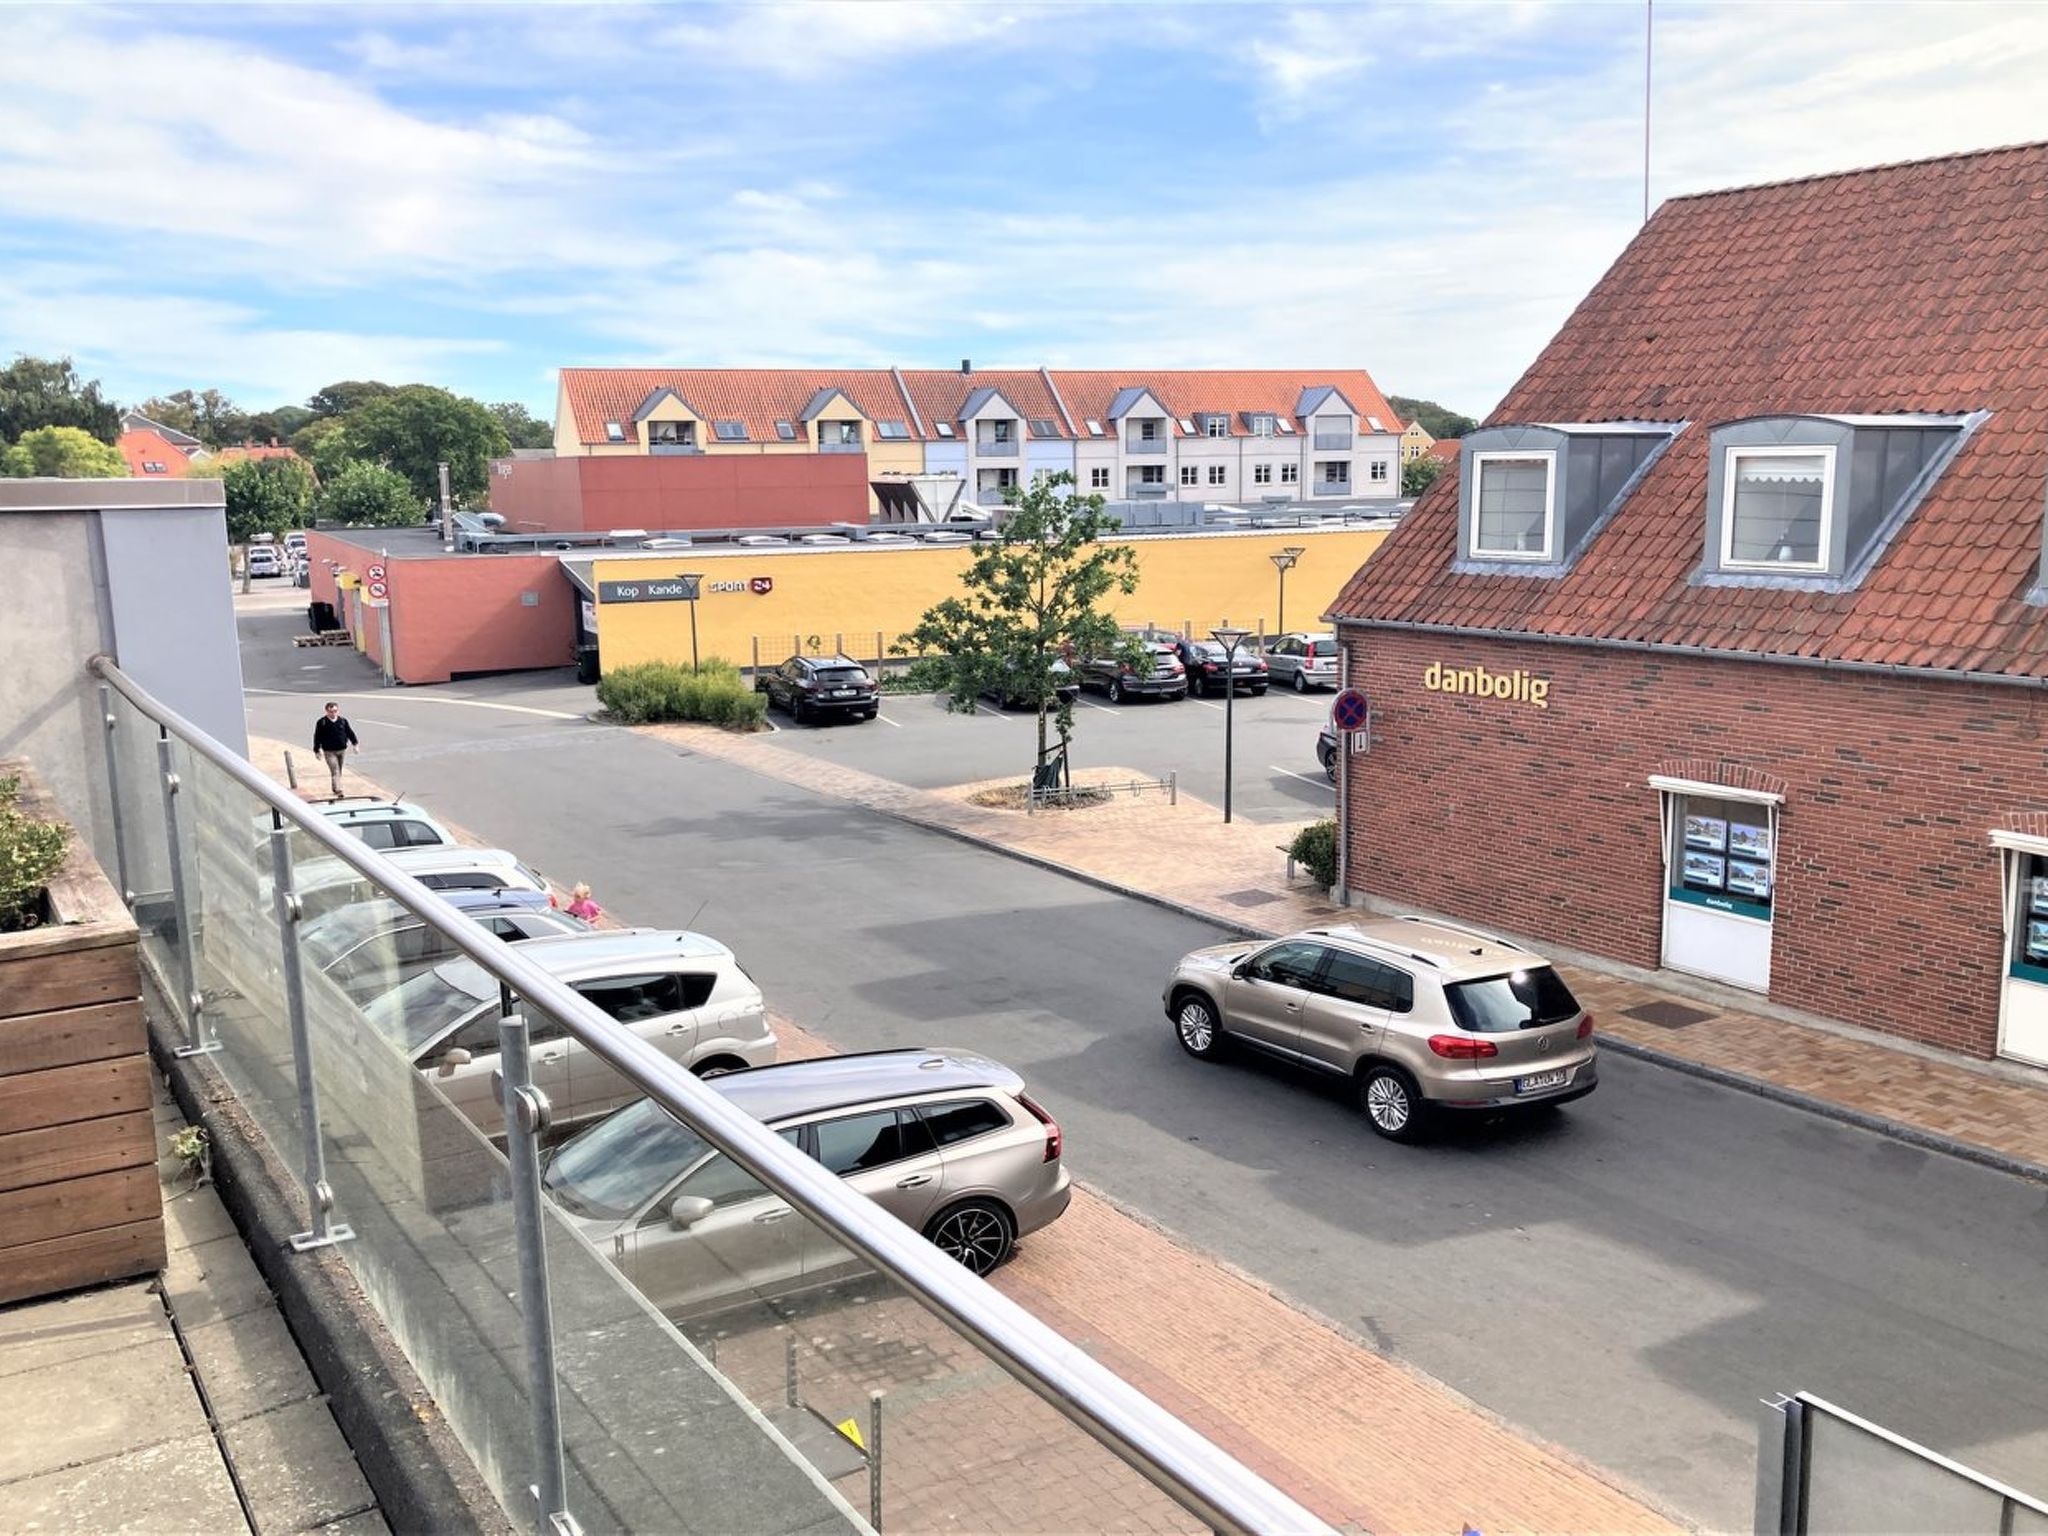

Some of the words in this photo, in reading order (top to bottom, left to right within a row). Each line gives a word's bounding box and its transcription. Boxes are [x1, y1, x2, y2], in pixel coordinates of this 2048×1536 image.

[616, 585, 640, 598] Kop
[648, 583, 683, 595] Kande
[1425, 661, 1549, 709] danbolig
